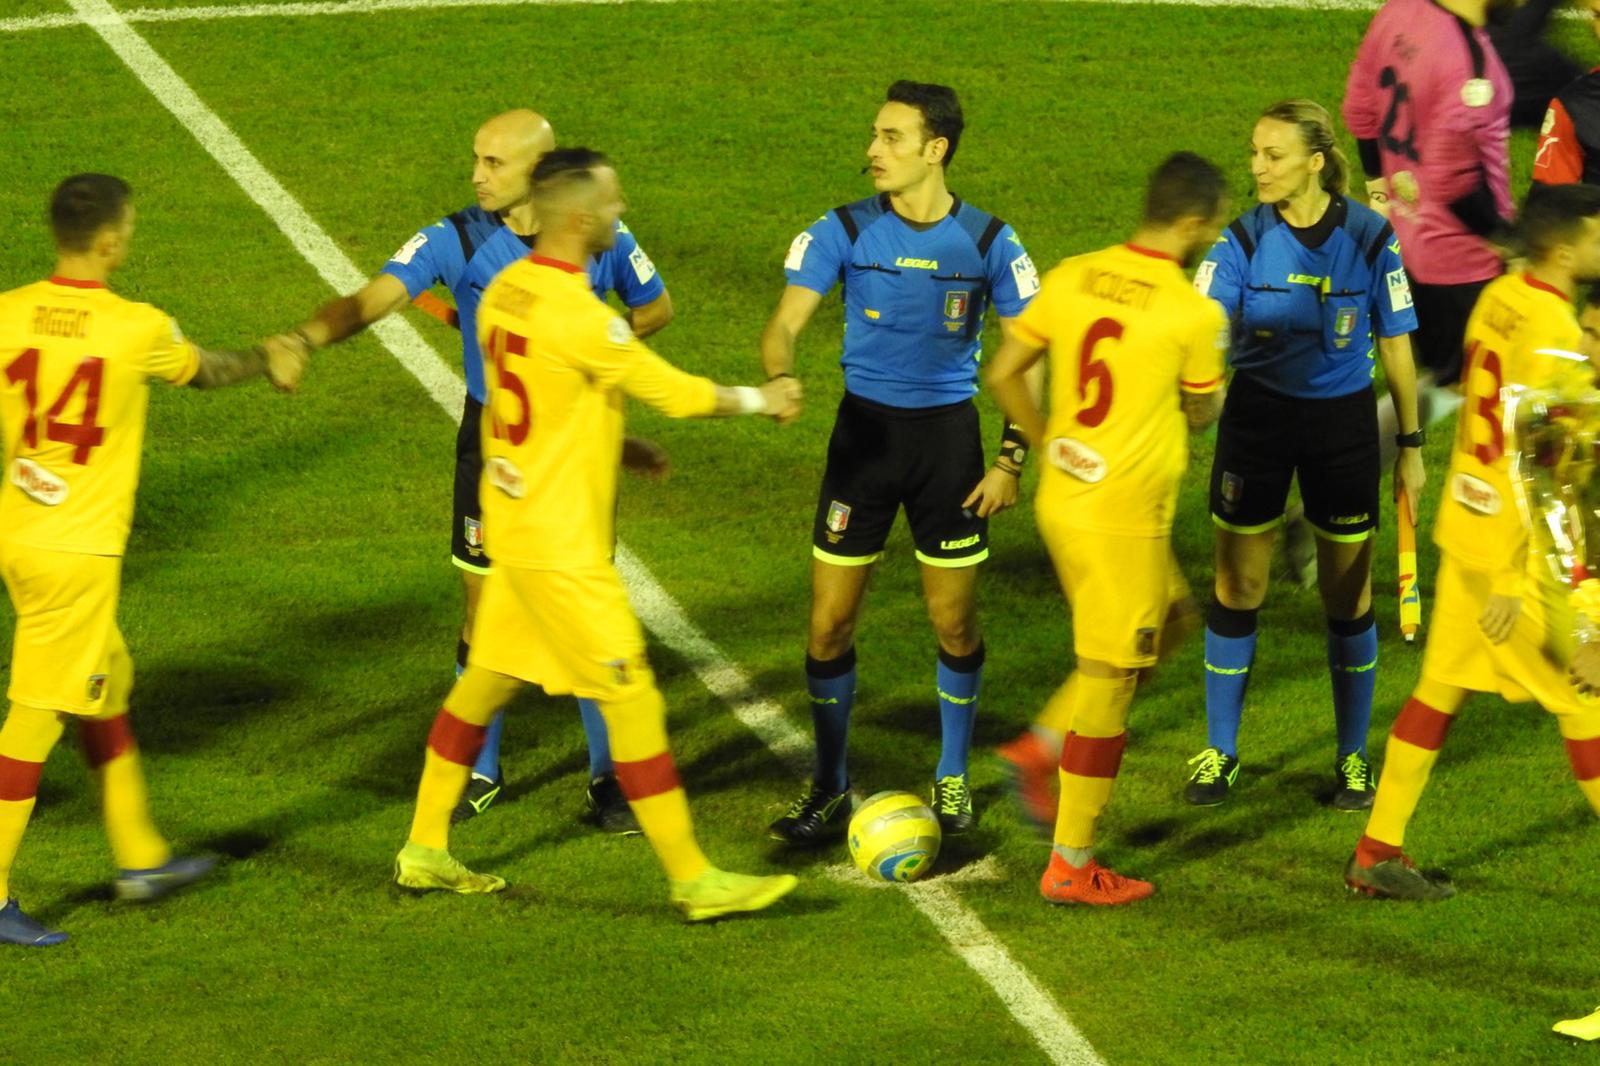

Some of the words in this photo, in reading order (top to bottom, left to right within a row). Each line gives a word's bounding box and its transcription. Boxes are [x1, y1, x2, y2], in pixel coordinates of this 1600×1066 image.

[895, 256, 939, 271] LEGEA
[1076, 317, 1125, 429] 6
[4, 347, 105, 467] 14
[940, 534, 981, 550] LEGEA
